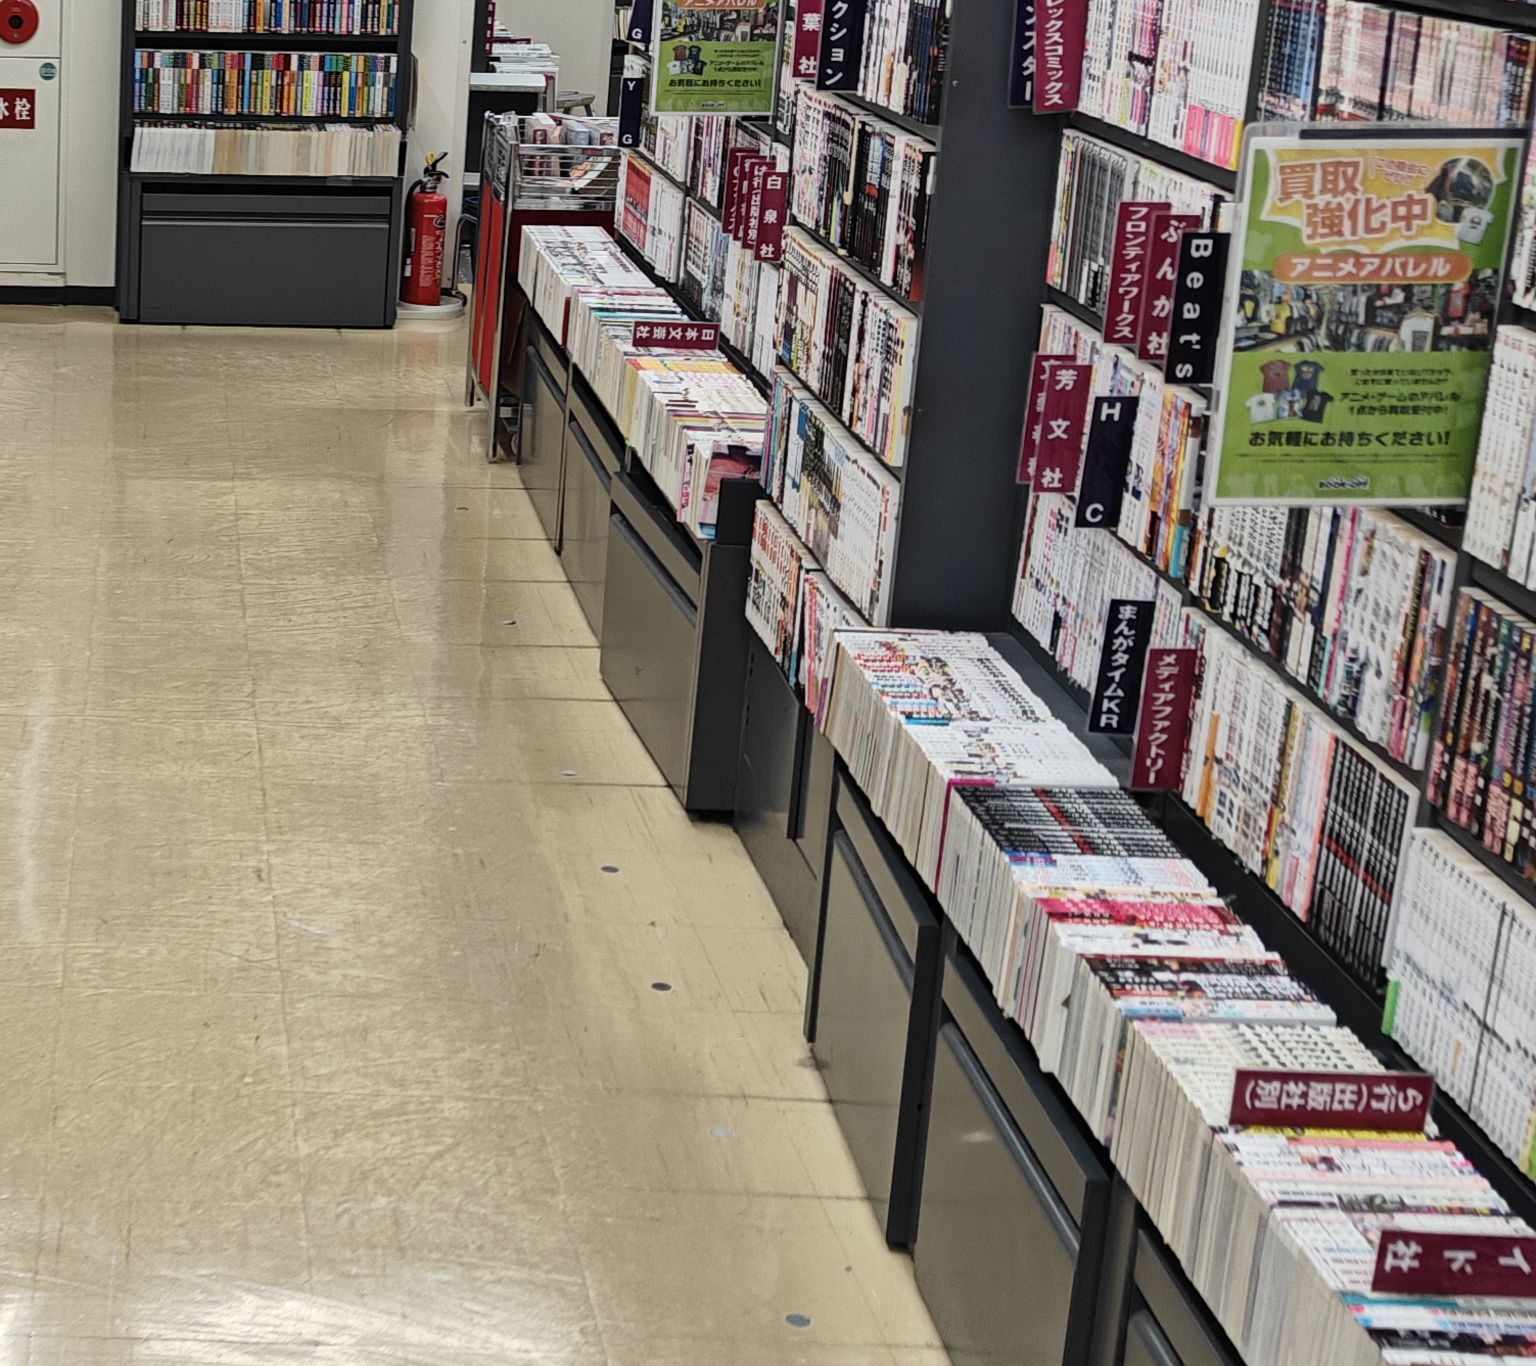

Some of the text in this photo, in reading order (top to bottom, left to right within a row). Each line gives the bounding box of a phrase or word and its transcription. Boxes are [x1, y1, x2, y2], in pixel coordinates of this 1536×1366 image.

[1278, 161, 1360, 205] 買取
[760, 176, 782, 259] 白泉社
[1304, 194, 1431, 240] 強化中
[1115, 206, 1147, 339] フロンティアワークス
[1290, 256, 1450, 279] アニメアパレル
[636, 325, 714, 341] 日本文芸社
[1042, 370, 1078, 488] 芳文社
[1249, 431, 1450, 448] お気軽にお持ちください!
[1096, 604, 1139, 730] まんがタイムKR
[1144, 653, 1178, 783] メディアファクトリー
[1245, 1080, 1424, 1113] ら行(出版社別)
